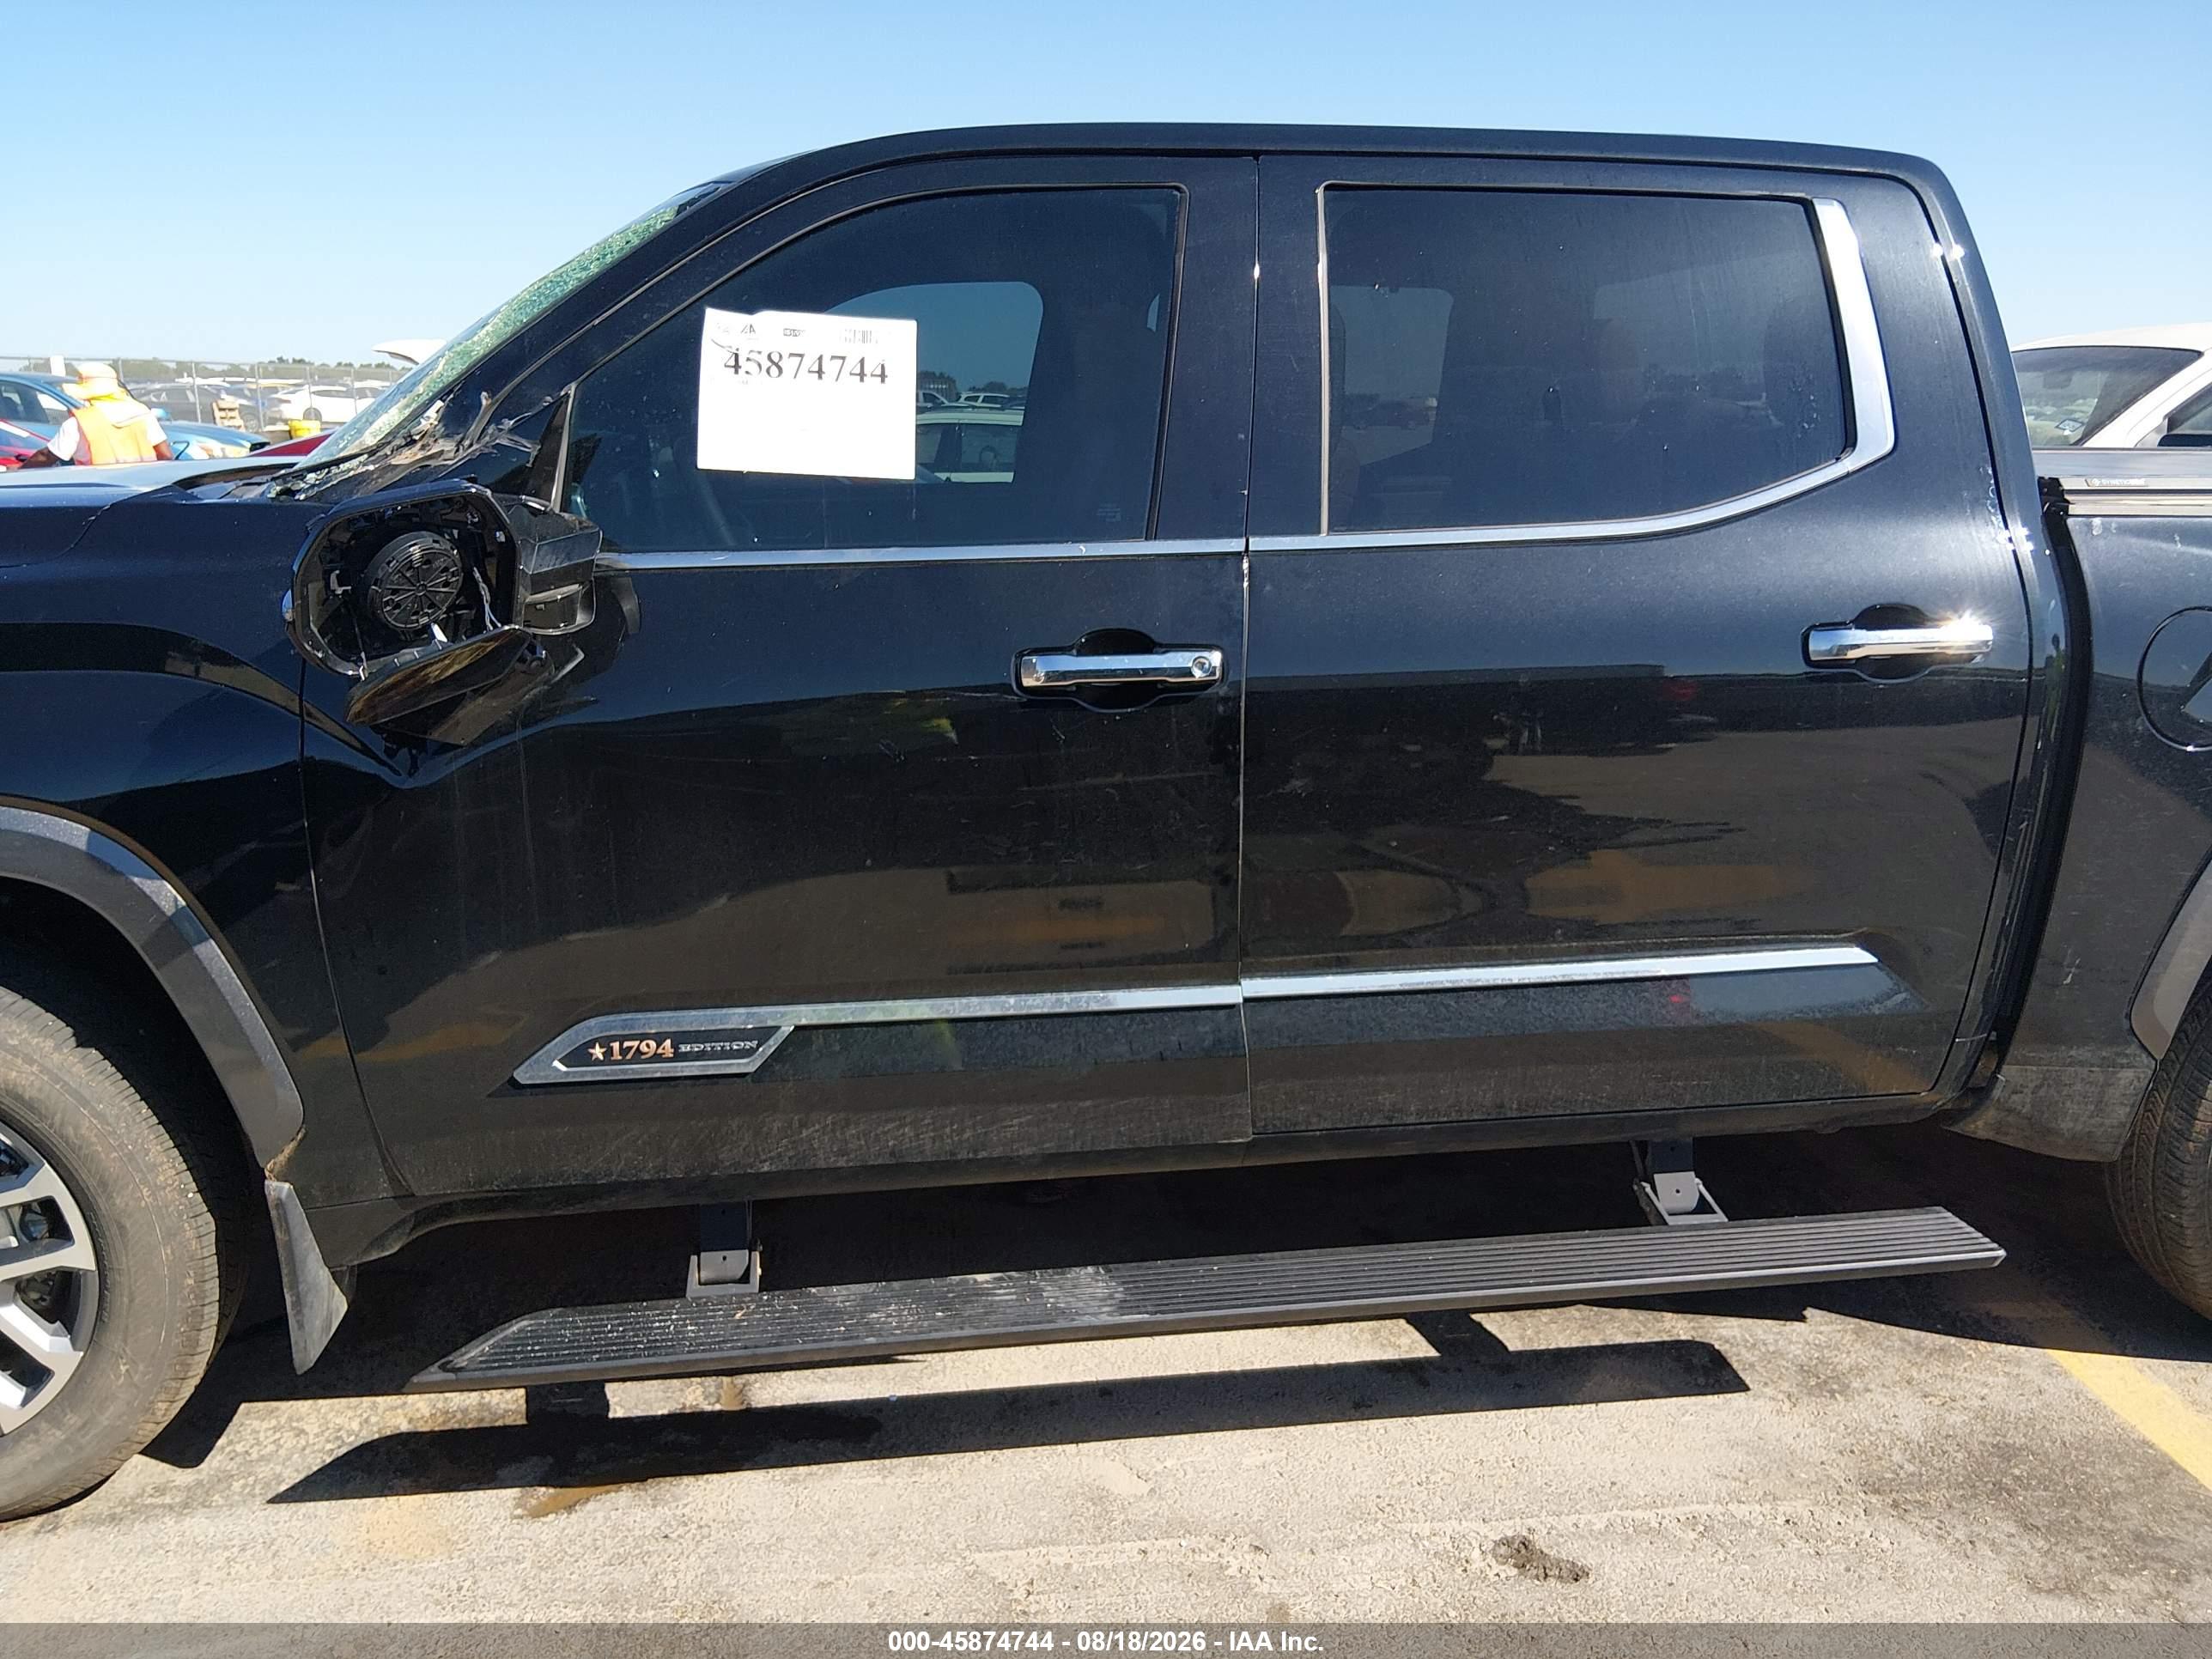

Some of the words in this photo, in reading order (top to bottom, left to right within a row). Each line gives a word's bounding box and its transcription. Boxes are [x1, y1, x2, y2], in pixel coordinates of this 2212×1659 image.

[723, 348, 889, 385] 45874744
[610, 1039, 674, 1060] 1794
[679, 1041, 758, 1053] EDITION
